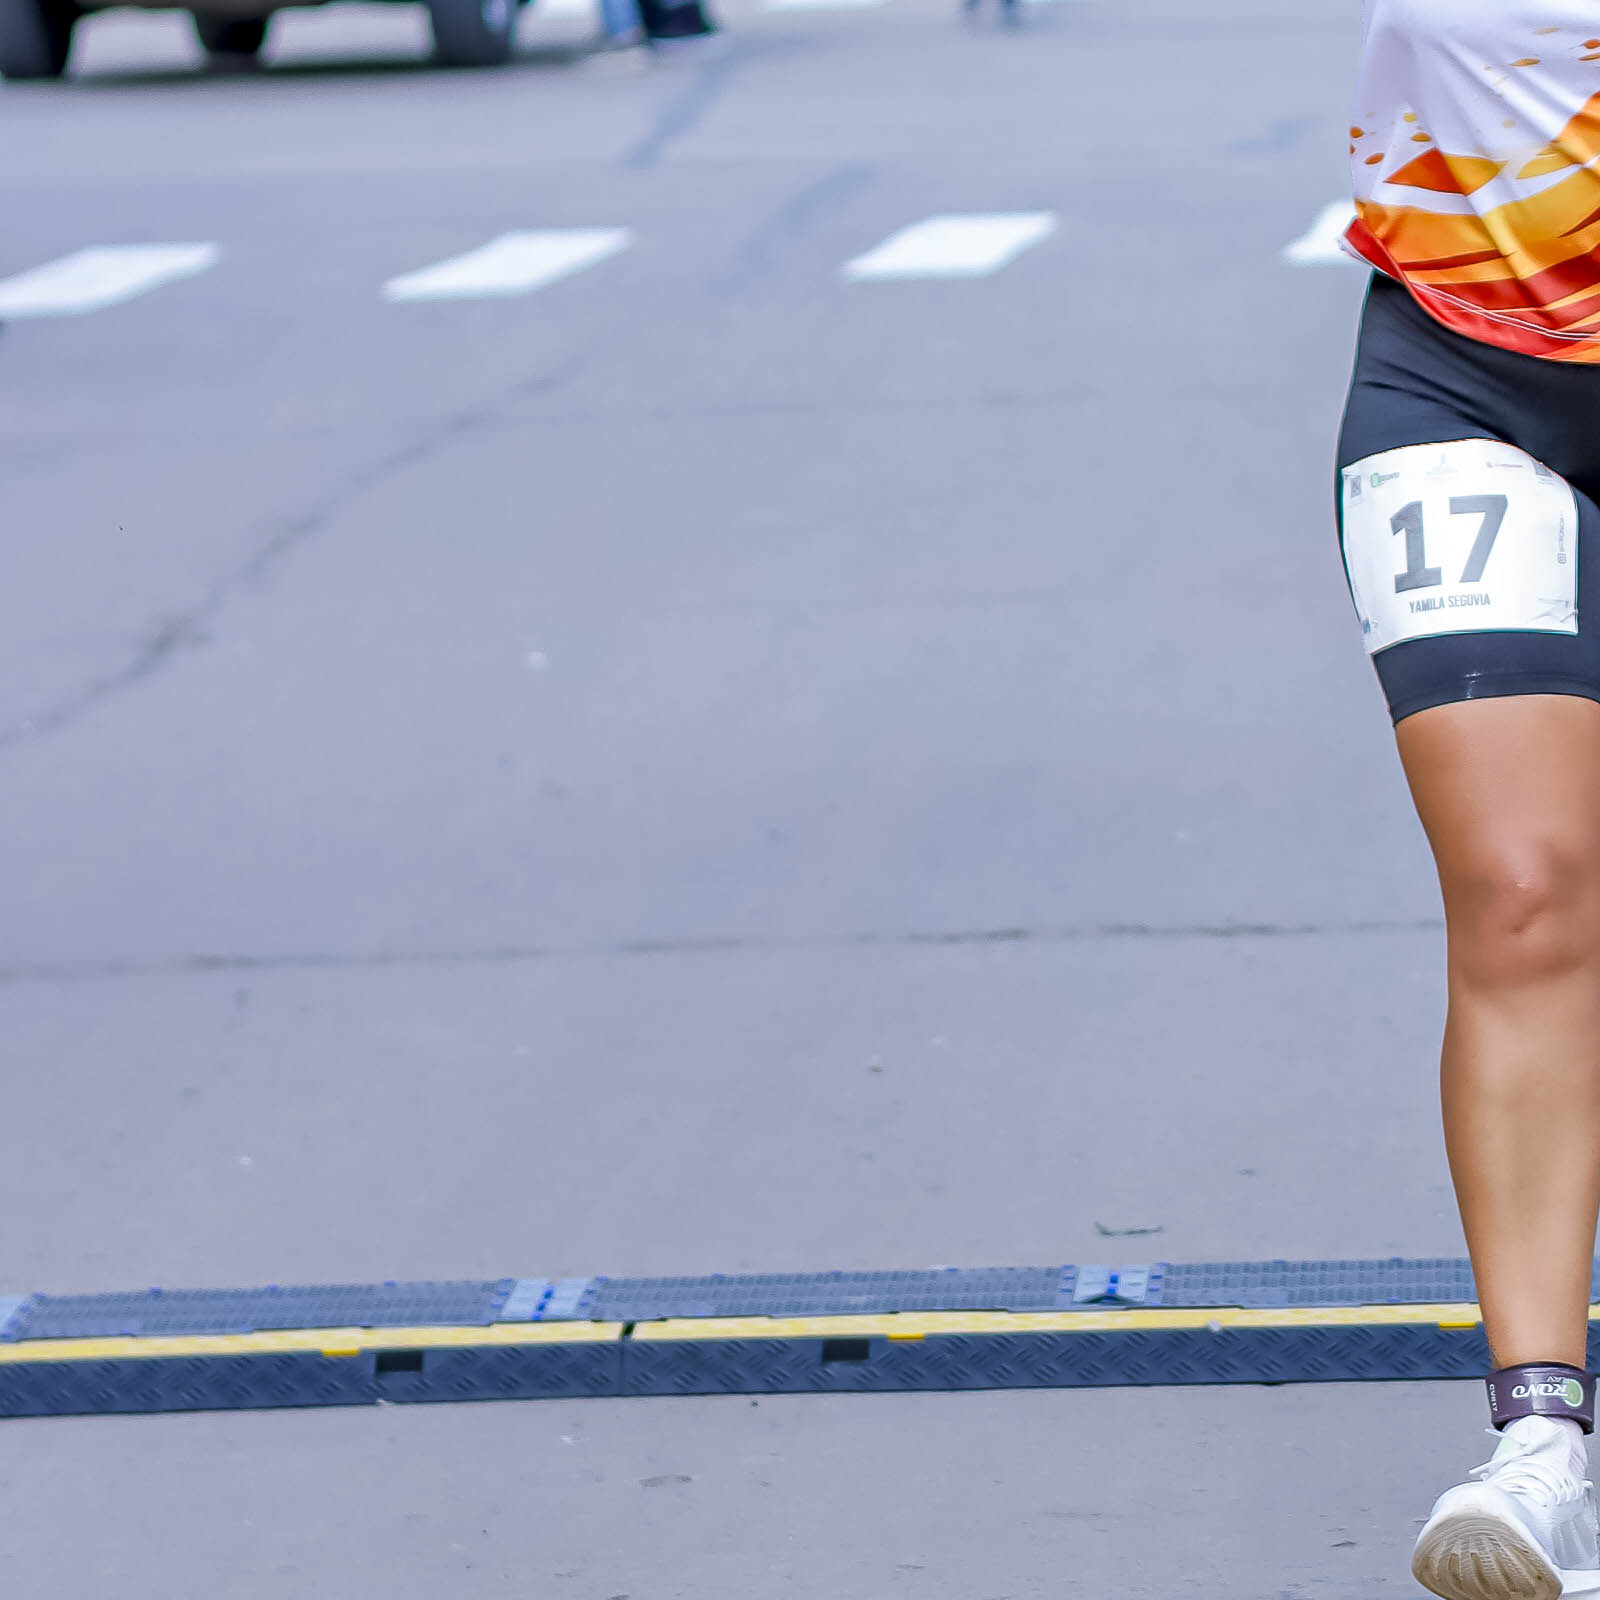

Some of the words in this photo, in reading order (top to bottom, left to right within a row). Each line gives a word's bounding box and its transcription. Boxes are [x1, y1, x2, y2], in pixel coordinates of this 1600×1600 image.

[1390, 494, 1509, 594] 17
[1409, 596, 1446, 614] YAMILA
[1448, 593, 1491, 608] SEGOVIA
